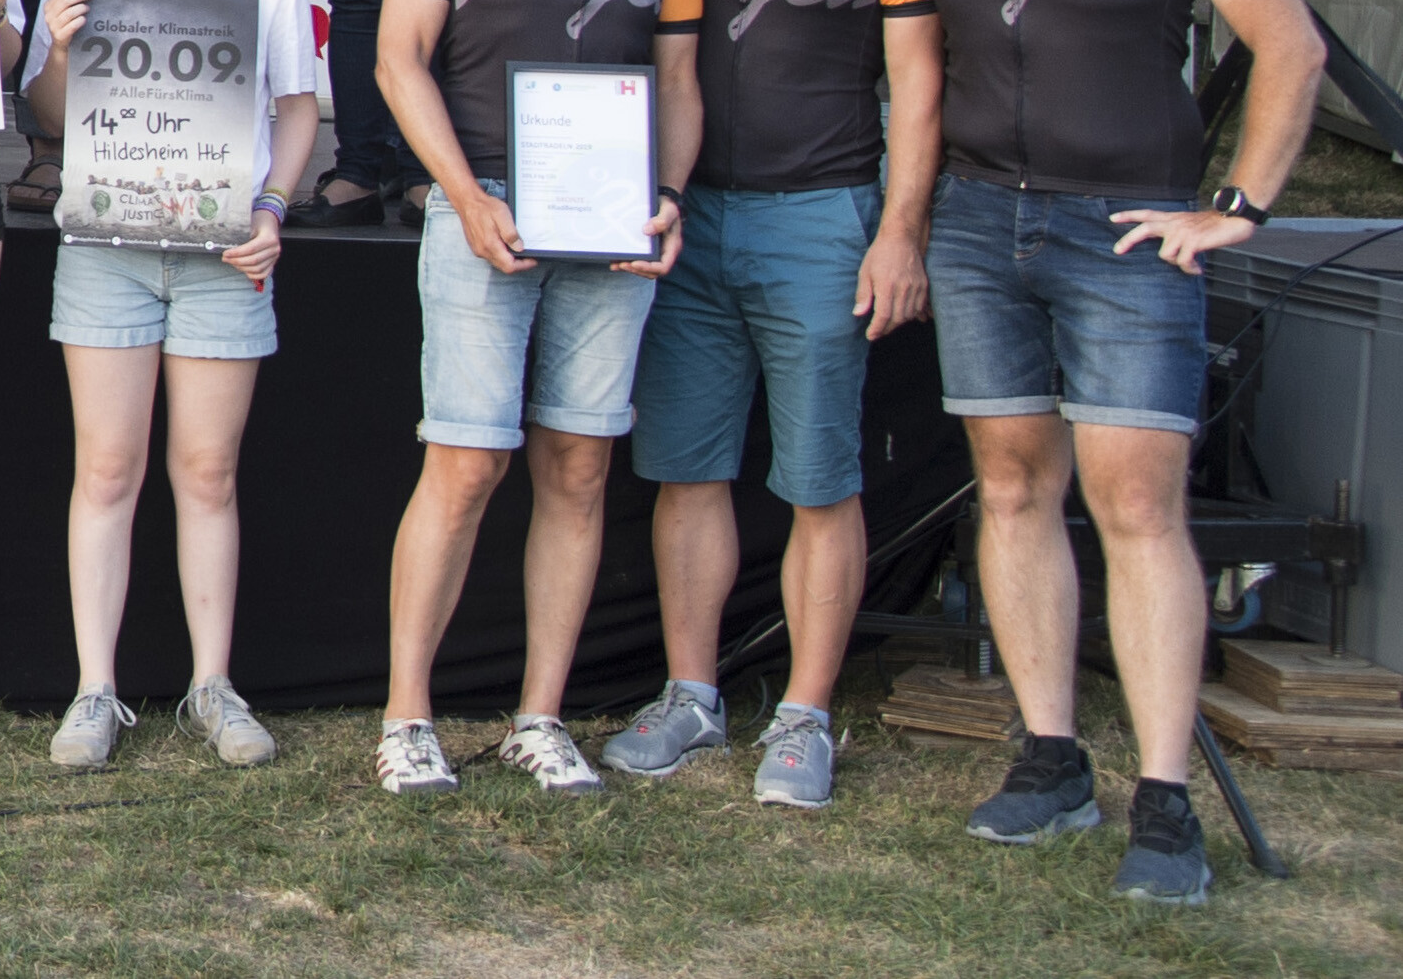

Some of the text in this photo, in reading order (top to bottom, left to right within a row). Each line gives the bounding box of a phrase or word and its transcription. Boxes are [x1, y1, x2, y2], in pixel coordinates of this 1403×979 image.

[94, 20, 235, 37] Globaler Klimastreik
[79, 36, 246, 85] 20.09.
[109, 86, 213, 102] #AlleFürsKlima
[146, 110, 191, 134] Uhr
[521, 113, 572, 126] Urkunde
[94, 140, 230, 165] Hildesheim Hbf
